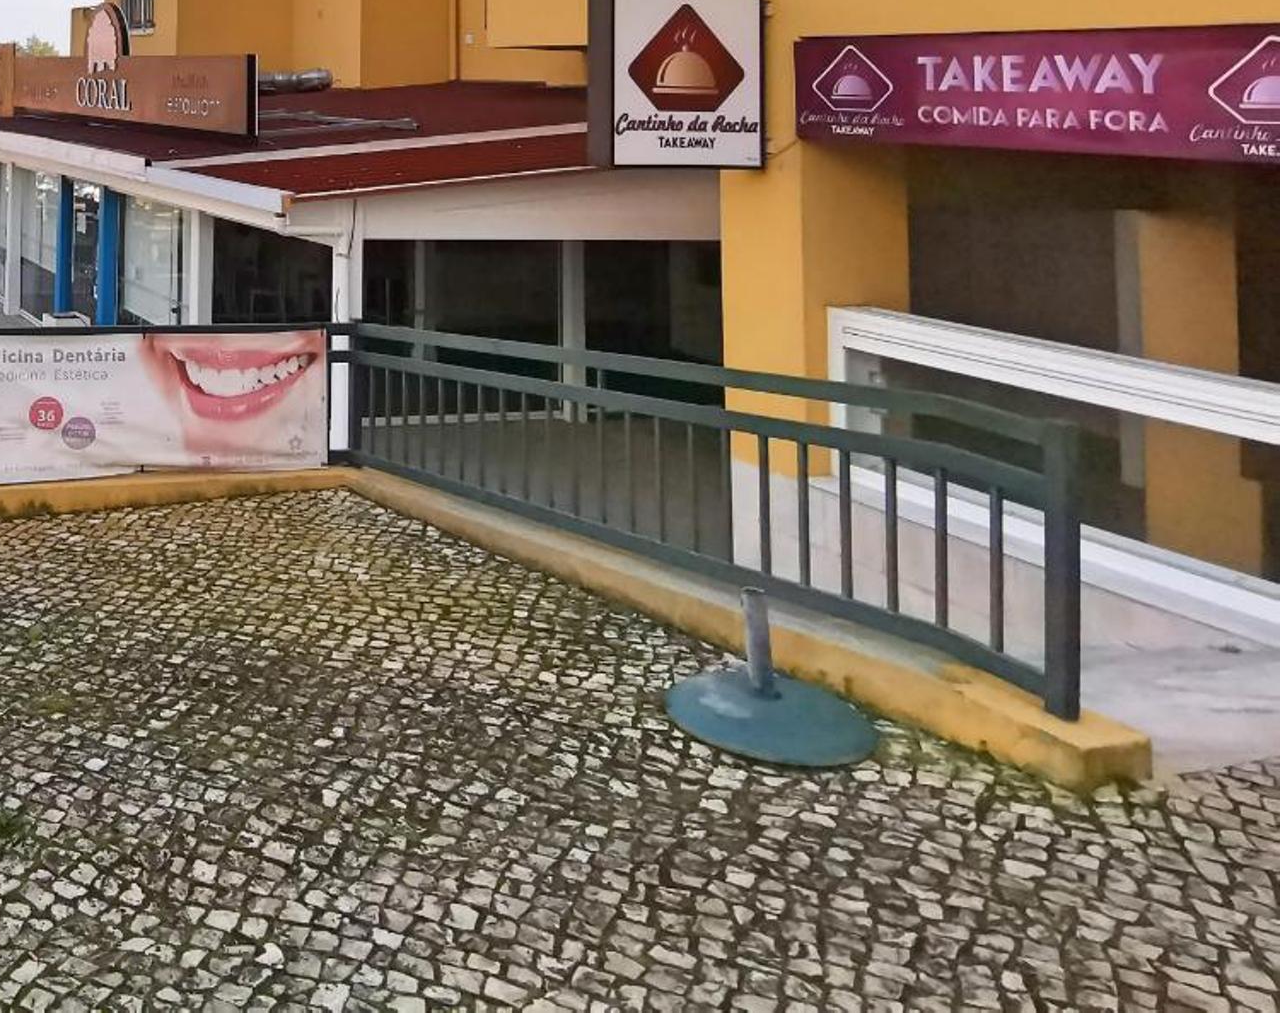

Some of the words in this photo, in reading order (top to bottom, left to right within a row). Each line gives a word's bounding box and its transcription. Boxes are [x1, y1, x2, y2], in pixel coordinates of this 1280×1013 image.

[917, 53, 1164, 94] TAKEAWAY
[76, 77, 133, 111] CORAL
[616, 113, 683, 135] Cantinho
[686, 115, 708, 133] da
[712, 115, 759, 133] Rocha
[917, 106, 1009, 127] COMIDA
[1016, 107, 1081, 130] PARA
[1088, 109, 1169, 133] FORA
[831, 125, 874, 135] TAKEAWAY
[658, 137, 716, 149] TAKEAWAY
[1241, 144, 1280, 156] TAKE
[53, 348, 126, 363] Dentária
